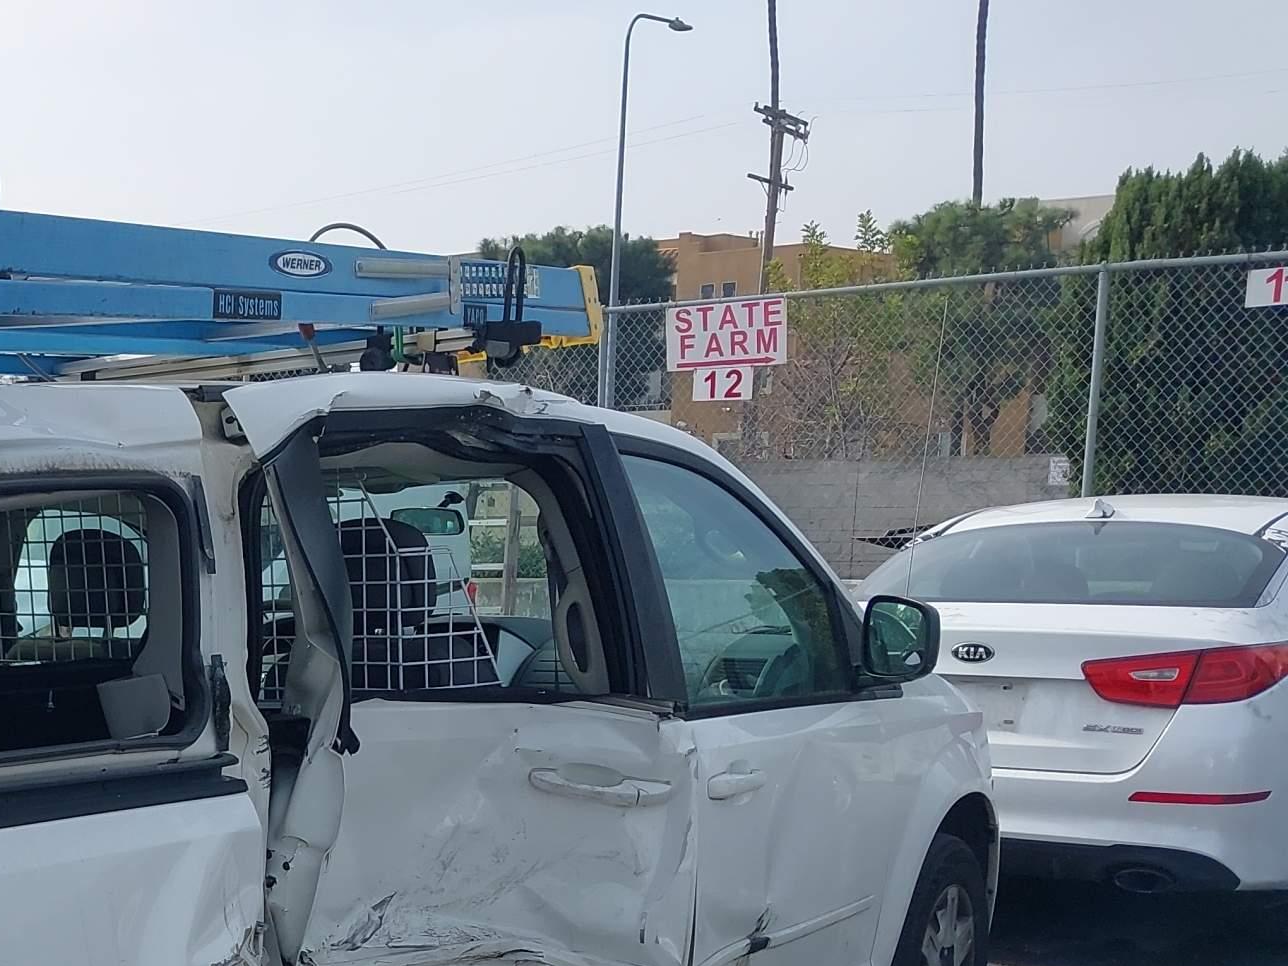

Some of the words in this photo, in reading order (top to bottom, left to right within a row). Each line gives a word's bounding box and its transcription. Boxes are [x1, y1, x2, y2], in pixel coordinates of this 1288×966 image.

[282, 256, 322, 271] WERNER
[1266, 268, 1288, 303] 1
[218, 294, 235, 314] HCI
[238, 295, 279, 316] Systems
[675, 300, 783, 333] STATE
[679, 327, 778, 359] FARM
[704, 369, 743, 399] 12
[958, 646, 987, 659] KIA
